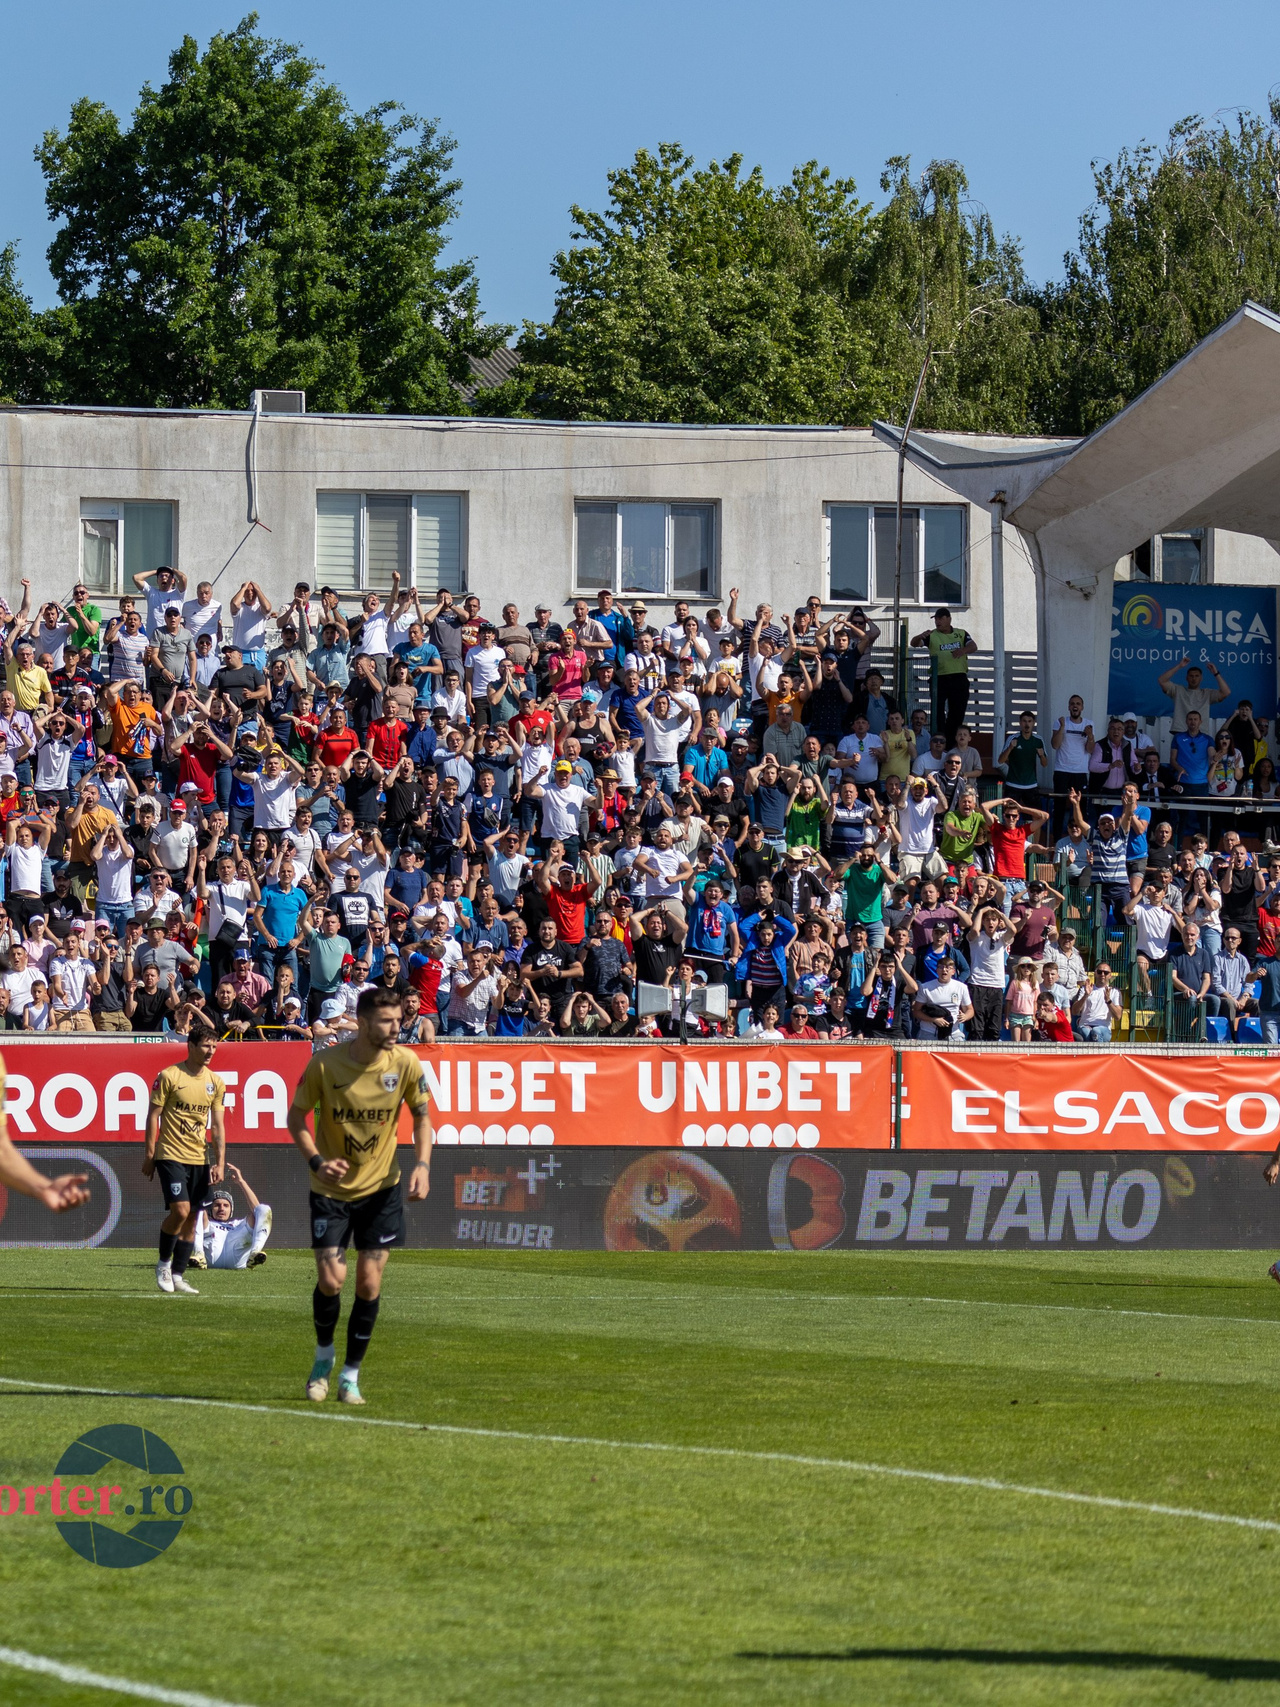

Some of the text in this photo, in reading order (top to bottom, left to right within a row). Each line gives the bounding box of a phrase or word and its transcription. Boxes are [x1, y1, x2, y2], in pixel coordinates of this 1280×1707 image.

[1111, 646, 1273, 666] quapark & sports
[418, 1061, 597, 1112] NIBET
[638, 1061, 862, 1112] UNIBET
[332, 1108, 394, 1122] MAXBET
[951, 1090, 1280, 1136] ELSACO
[461, 1180, 508, 1205] BET
[855, 1169, 1161, 1243] BETANO
[457, 1218, 554, 1248] BUILDER
